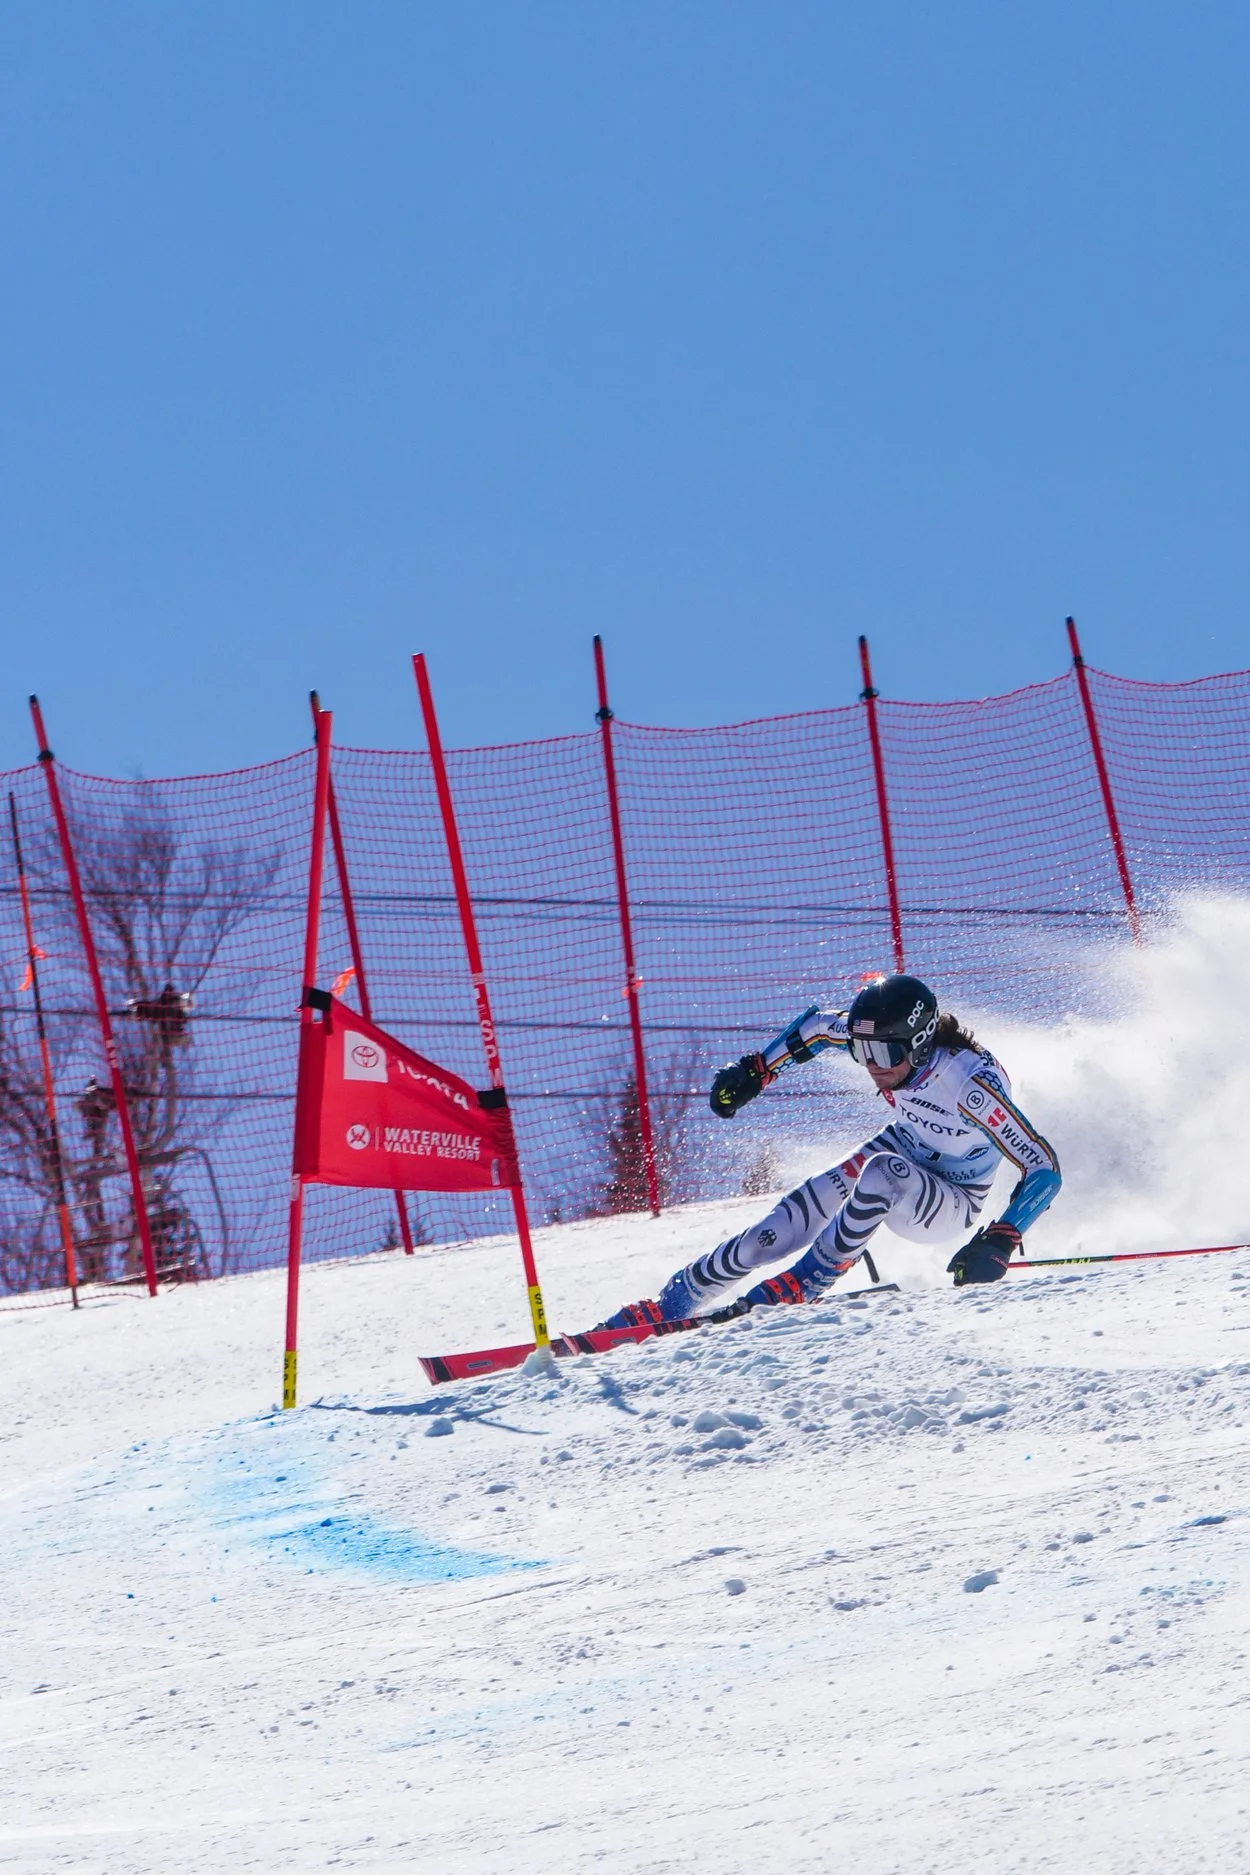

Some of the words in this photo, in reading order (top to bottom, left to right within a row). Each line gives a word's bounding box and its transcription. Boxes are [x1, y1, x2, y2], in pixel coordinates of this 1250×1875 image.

[898, 1103, 972, 1137] TOYOTA
[902, 1097, 955, 1118] BOSE
[383, 1140, 433, 1156] VALLEY
[436, 1146, 480, 1161] RESORT
[384, 1126, 482, 1151] WATERVILLE
[1000, 1123, 1045, 1167] WÜRTH
